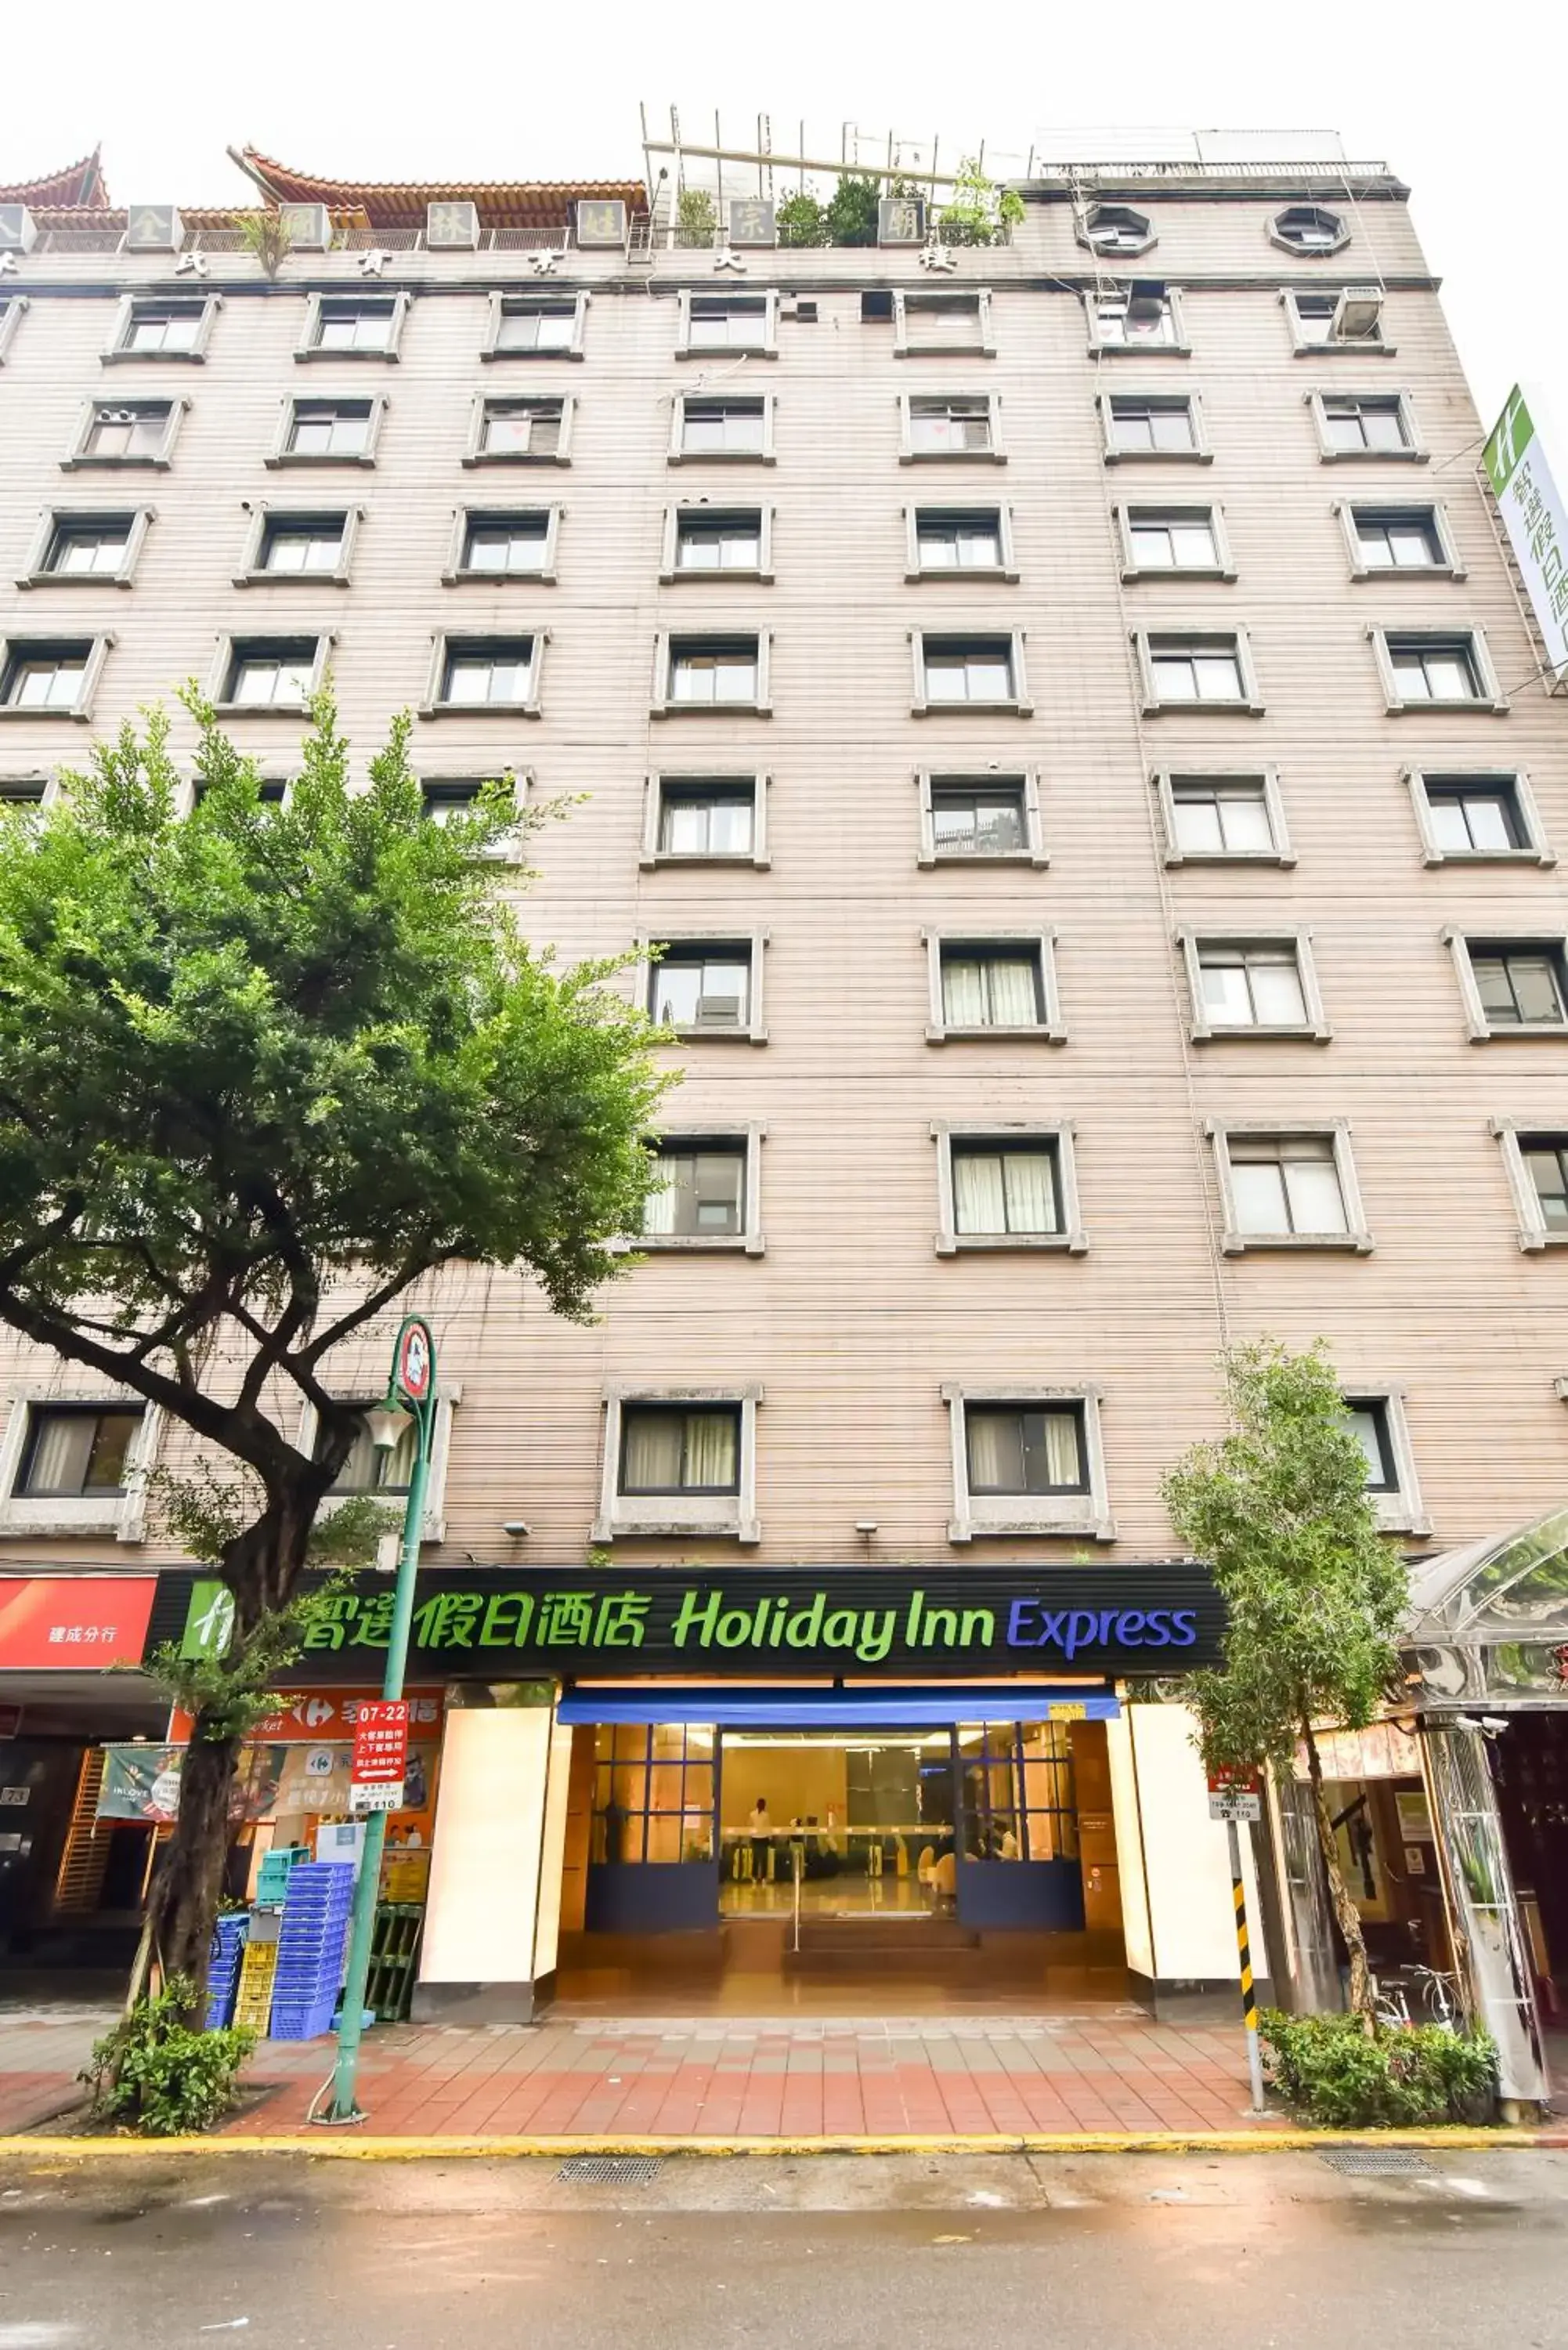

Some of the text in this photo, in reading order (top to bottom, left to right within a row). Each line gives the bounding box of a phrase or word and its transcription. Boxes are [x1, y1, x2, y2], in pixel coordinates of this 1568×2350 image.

[1512, 461, 1568, 652] 智選假日酒
[48, 1625, 118, 1643] 建成分行
[303, 1591, 652, 1650] 智選假日酒店
[671, 1591, 1197, 1661] Holiday Inn Express
[360, 1705, 406, 1723] 07-22
